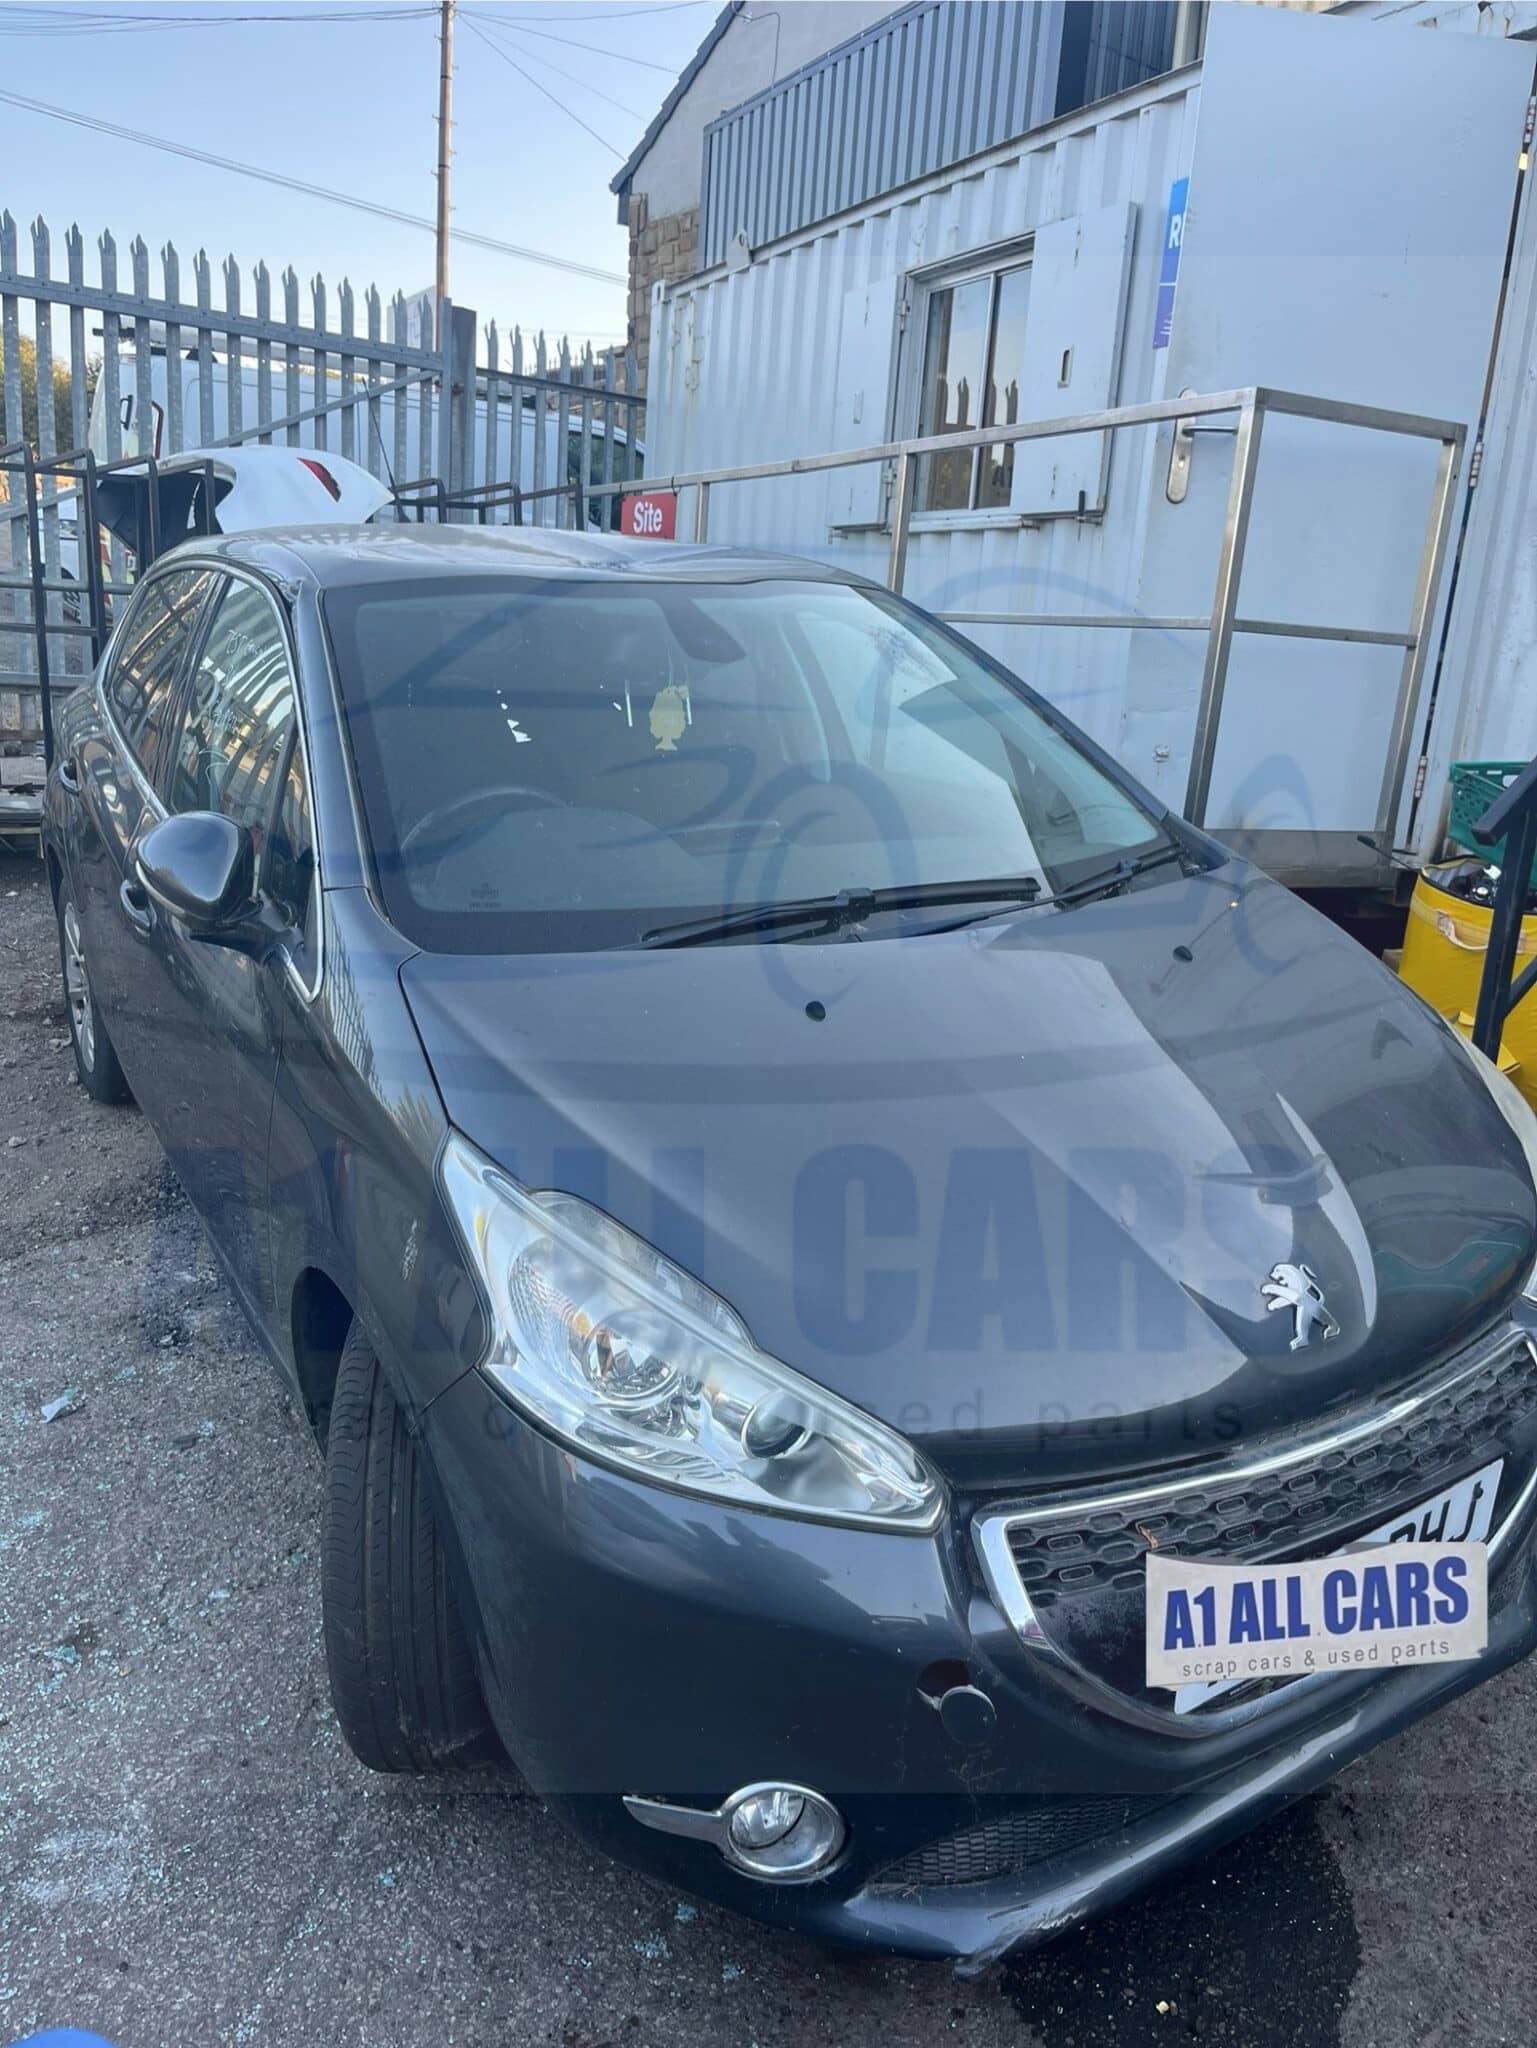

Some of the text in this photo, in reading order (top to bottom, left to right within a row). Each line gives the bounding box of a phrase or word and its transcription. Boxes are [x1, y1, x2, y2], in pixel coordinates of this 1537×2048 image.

[633, 501, 663, 533] Site
[1163, 1556, 1469, 1650] A1 ALL CARS
[1183, 1640, 1450, 1676] scrap cars & used parts
